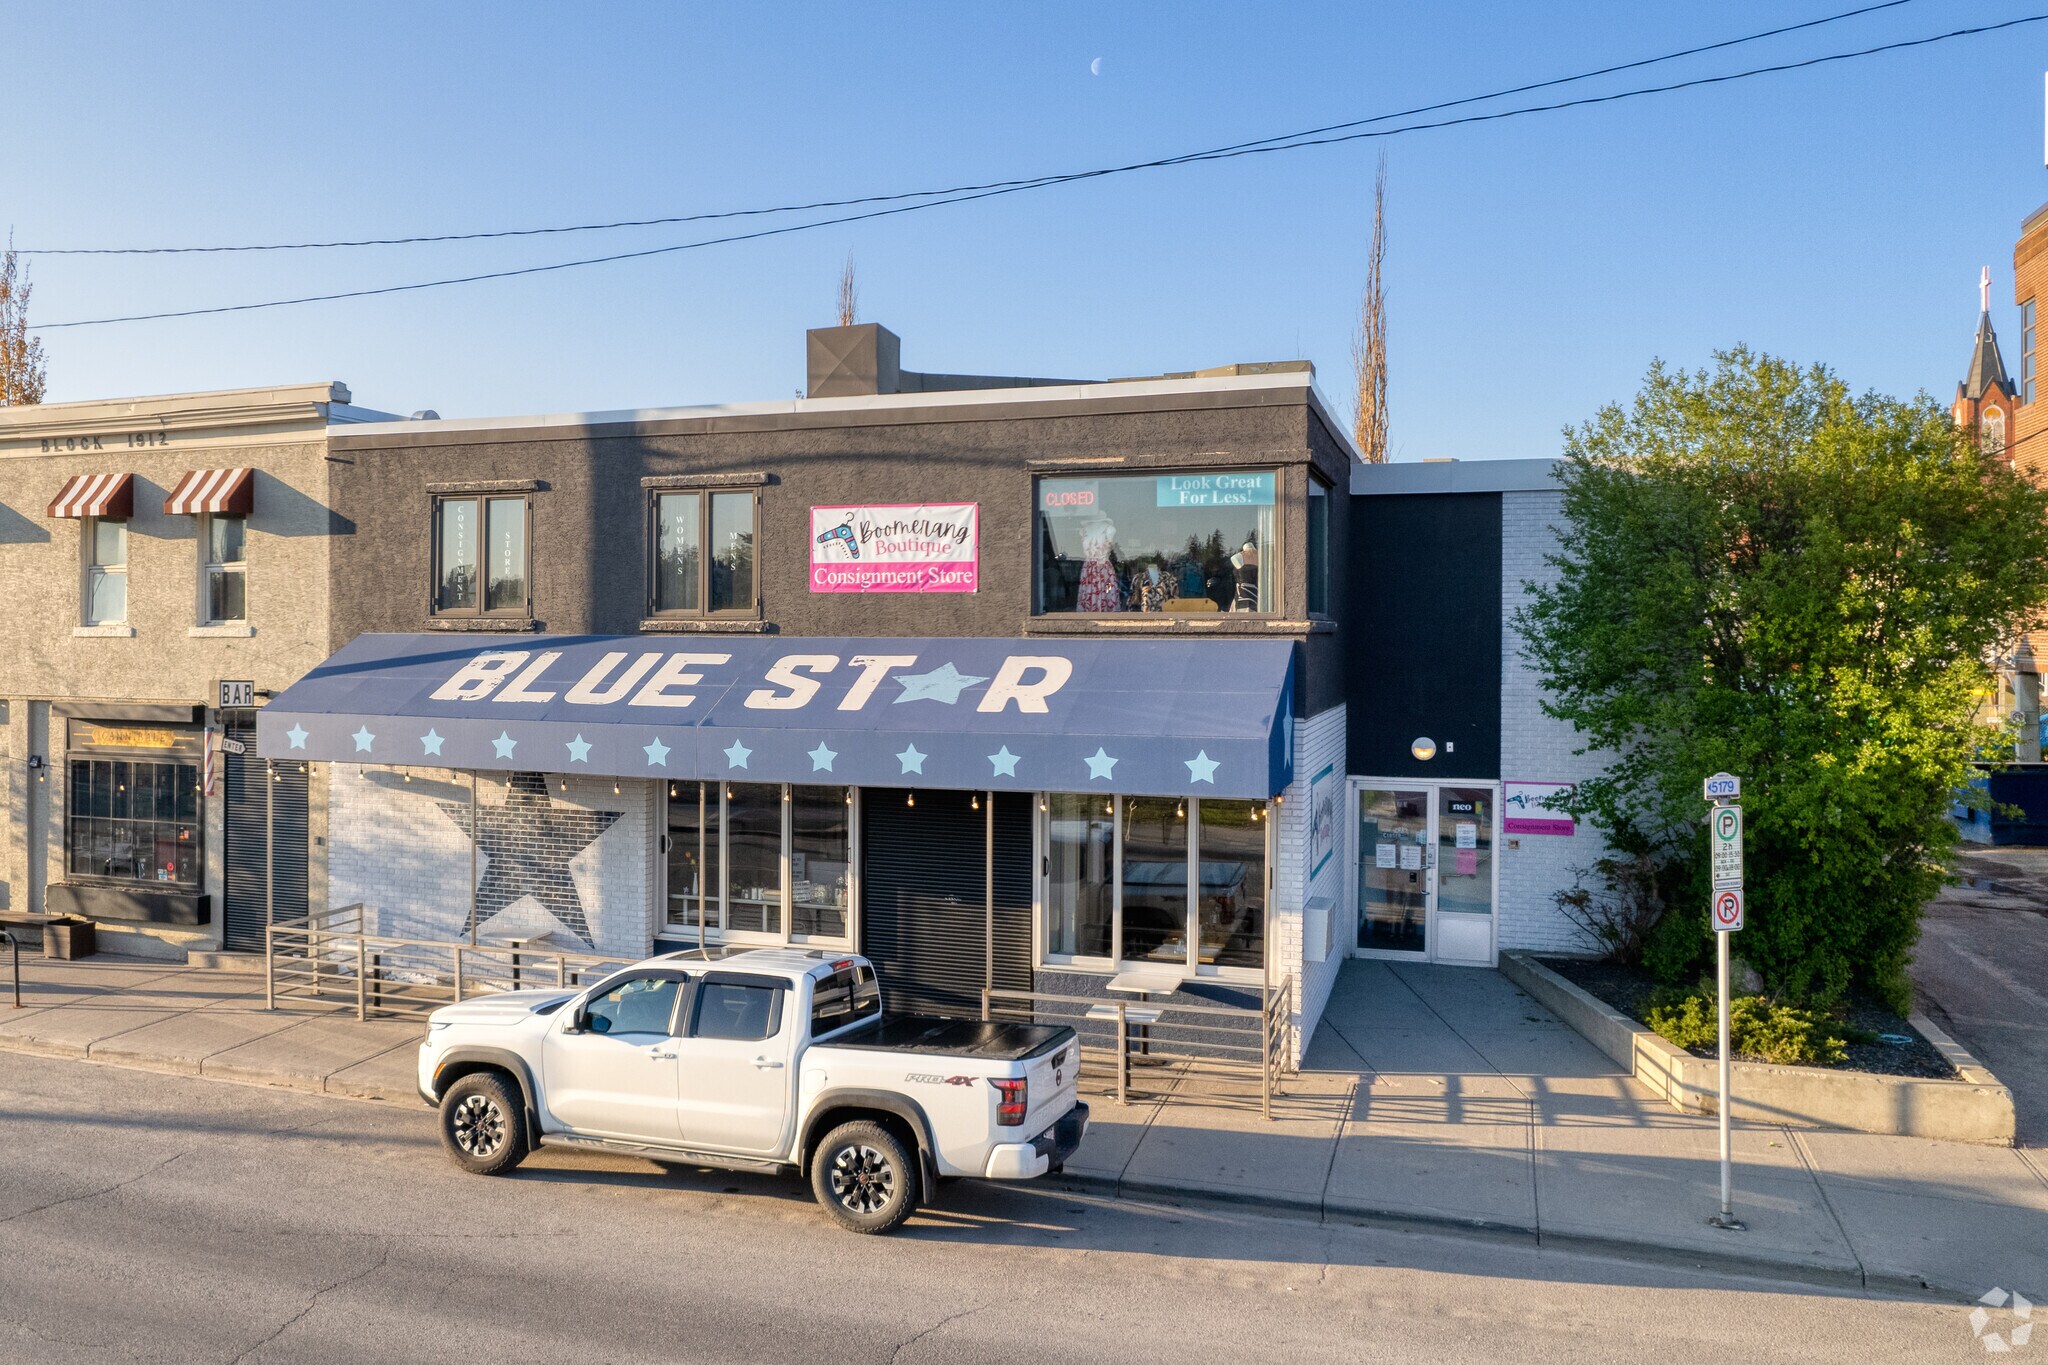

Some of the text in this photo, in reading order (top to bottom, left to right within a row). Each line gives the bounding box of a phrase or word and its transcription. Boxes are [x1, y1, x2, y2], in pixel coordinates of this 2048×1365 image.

[41, 431, 169, 453] BLOCK 1912
[1171, 475, 1262, 490] Look Great
[1046, 491, 1094, 506] CLOSED
[1179, 490, 1252, 504] For Less!
[860, 519, 971, 545] Boomerang
[676, 516, 684, 575] WOMENS
[729, 532, 738, 571] MENS
[875, 537, 951, 557] Boutique
[814, 566, 973, 587] Consignment Store
[429, 650, 732, 707] BLUE
[222, 684, 252, 704] BAR
[224, 740, 243, 752] ENTER
[1711, 780, 1734, 793] 5179
[1452, 802, 1472, 811] neo
[1722, 816, 1733, 835] P
[904, 1073, 979, 1087] PRO-4X
